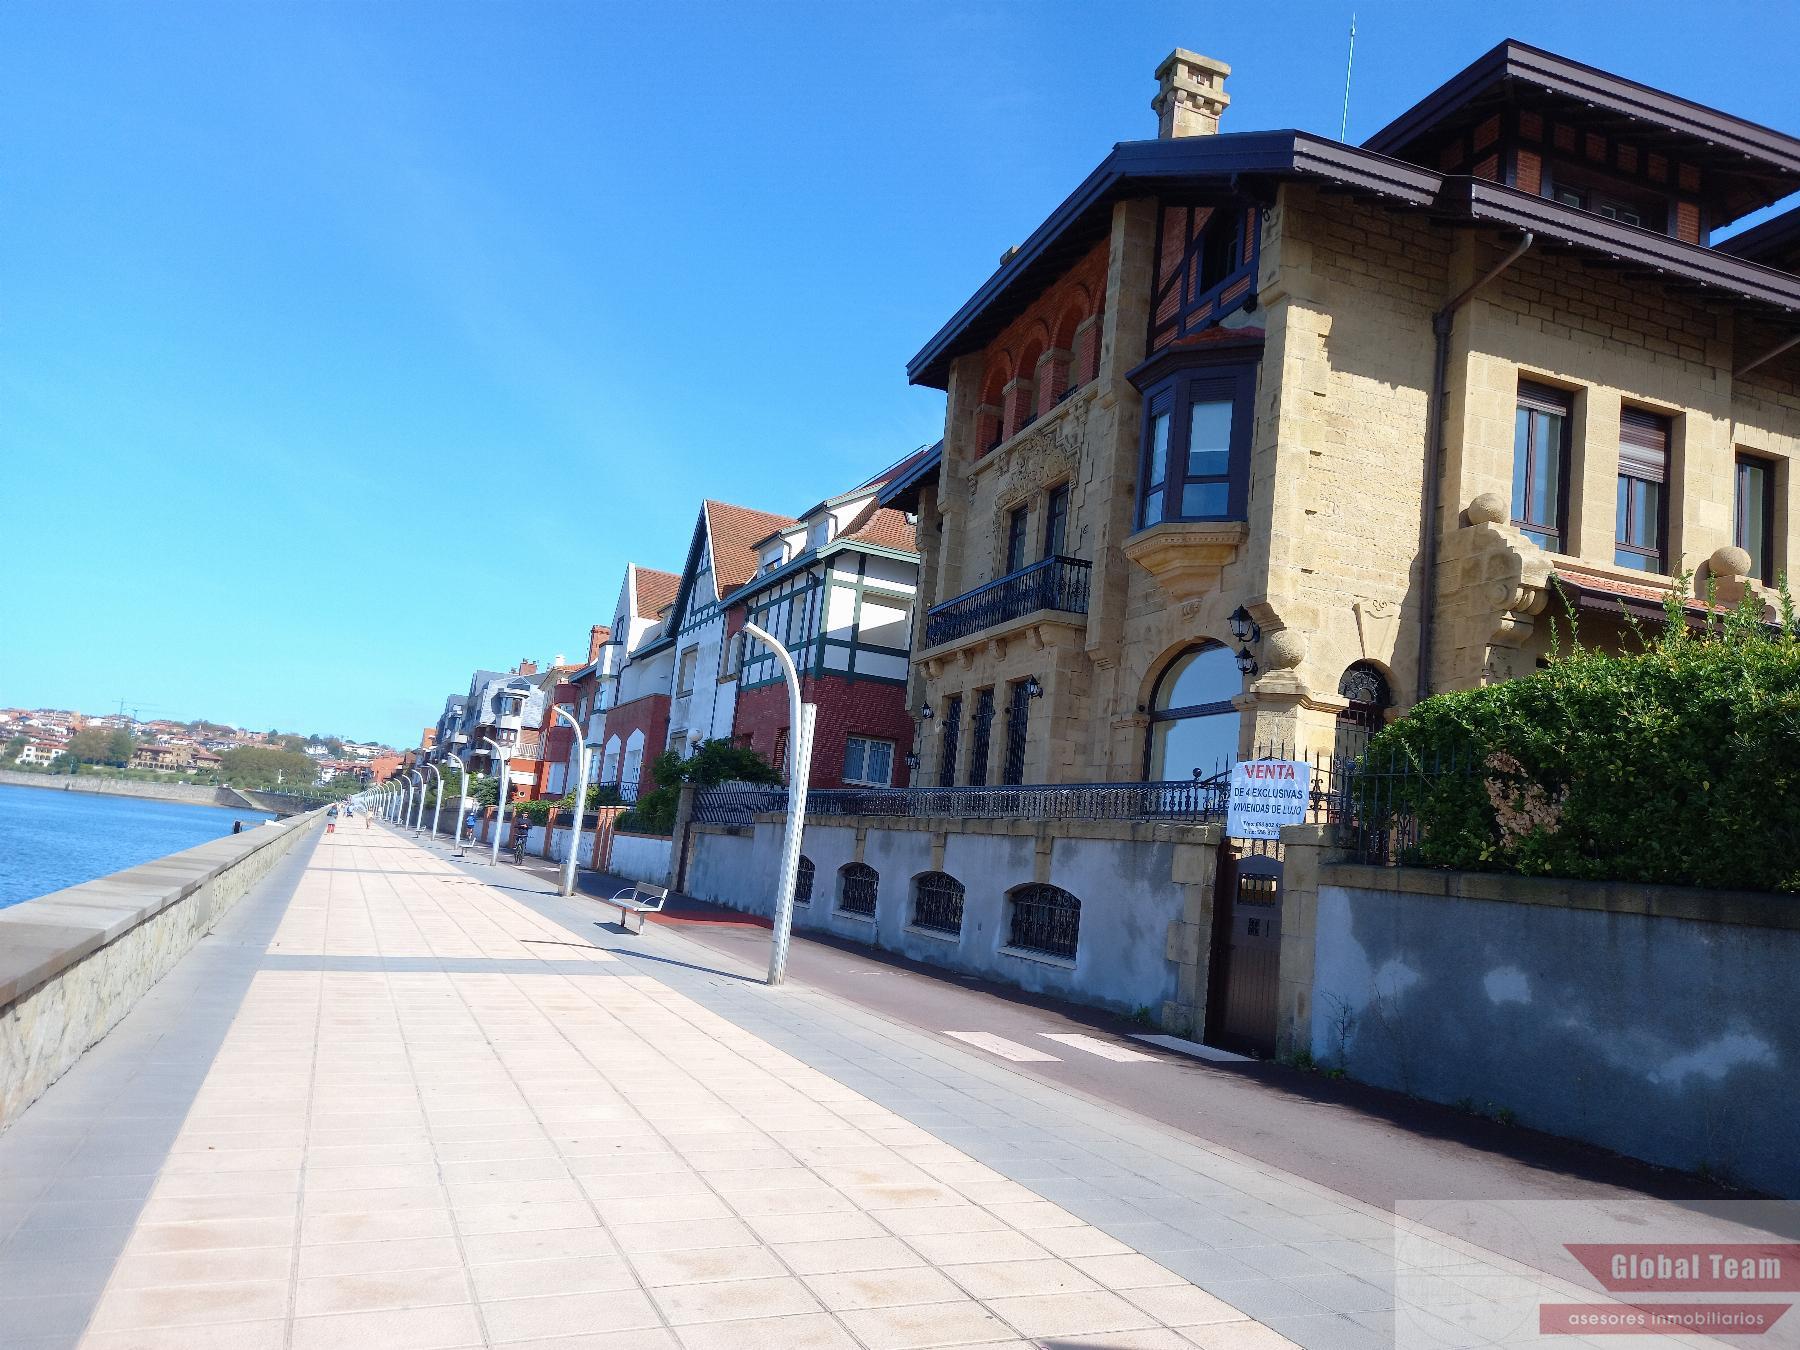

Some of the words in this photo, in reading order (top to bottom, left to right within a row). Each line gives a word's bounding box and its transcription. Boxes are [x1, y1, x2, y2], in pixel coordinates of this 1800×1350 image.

[1245, 764, 1295, 779] VENTA
[1234, 787, 1244, 796] DE
[1246, 787, 1250, 797] 4
[1253, 788, 1303, 799] EXCLUSIVAS
[1233, 803, 1270, 813] VIVIENDAS
[1271, 804, 1282, 814] DE
[1283, 805, 1302, 815] LUJO
